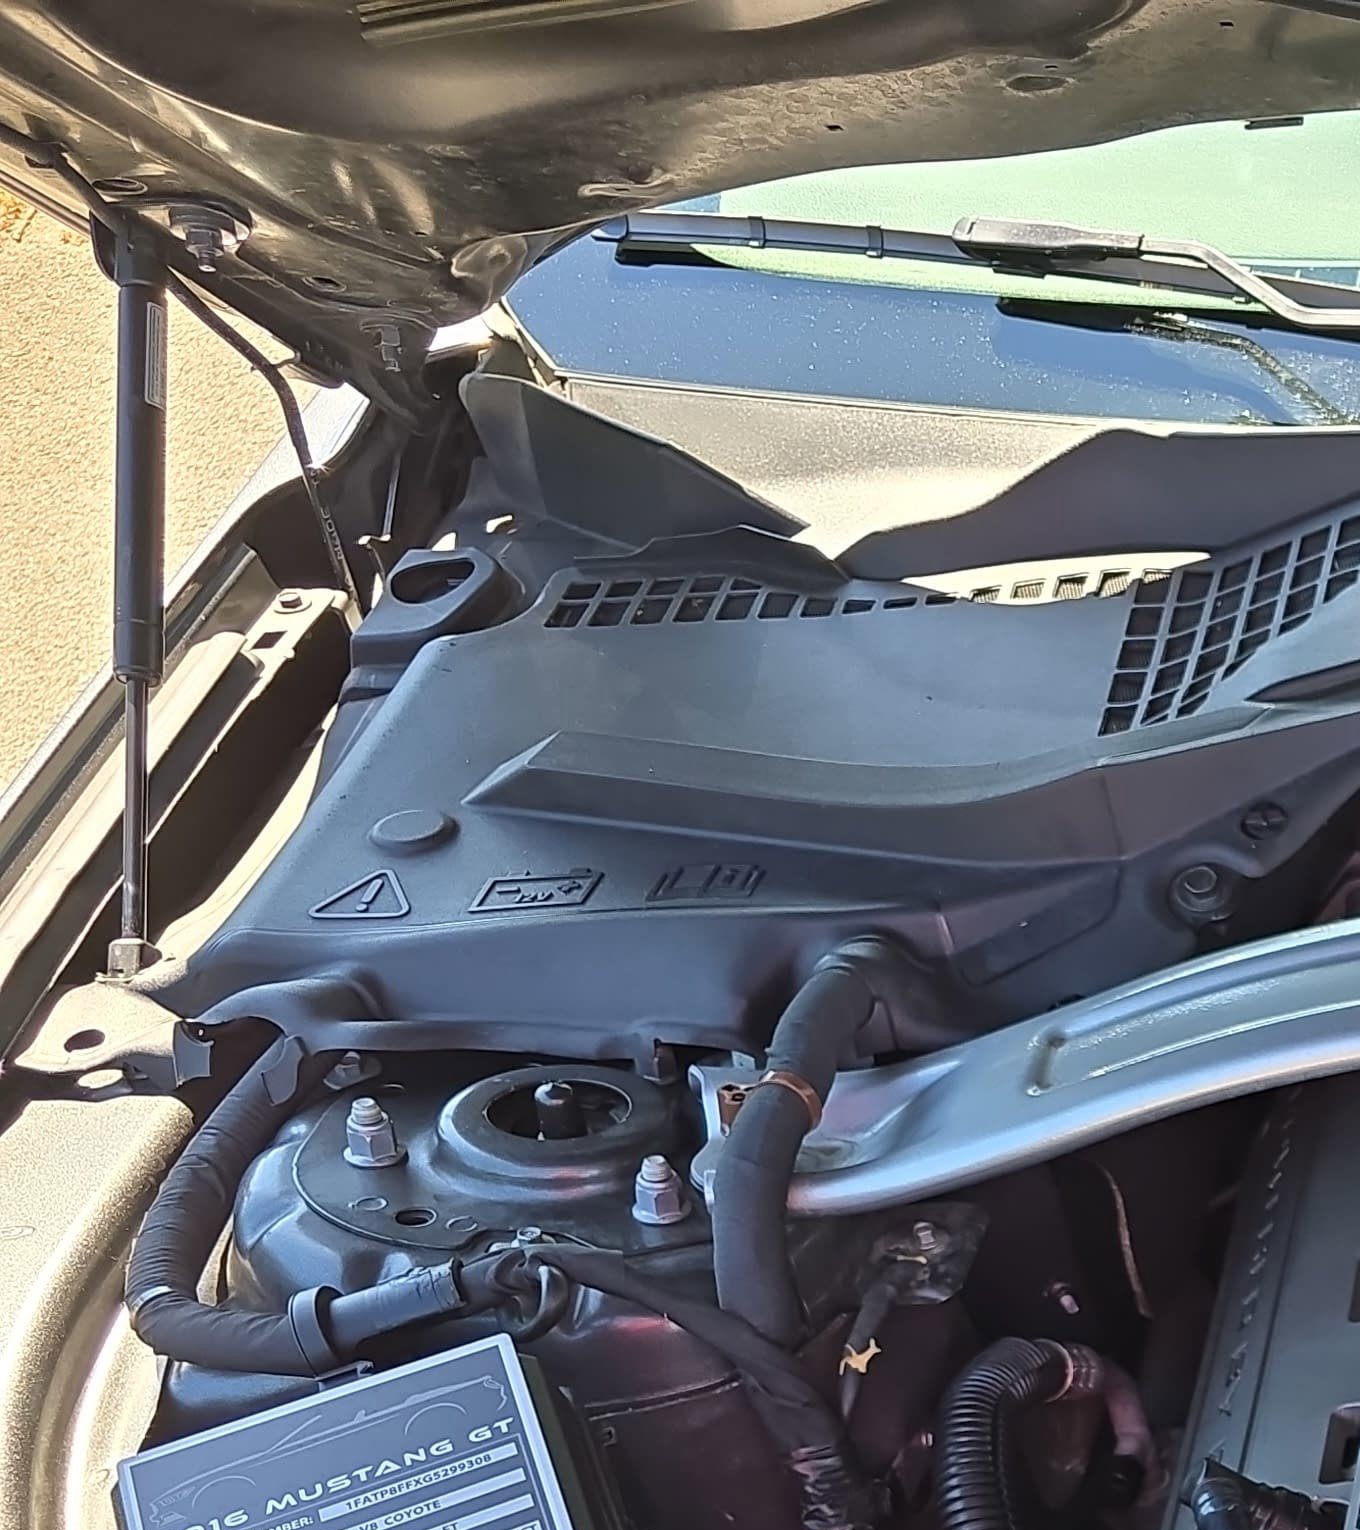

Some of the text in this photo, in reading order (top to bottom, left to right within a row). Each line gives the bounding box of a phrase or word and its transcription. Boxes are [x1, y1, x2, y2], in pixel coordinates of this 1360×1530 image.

[265, 1439, 454, 1515] MUSTANG
[468, 1417, 514, 1442] GT
[384, 1499, 442, 1526] COYOTE
